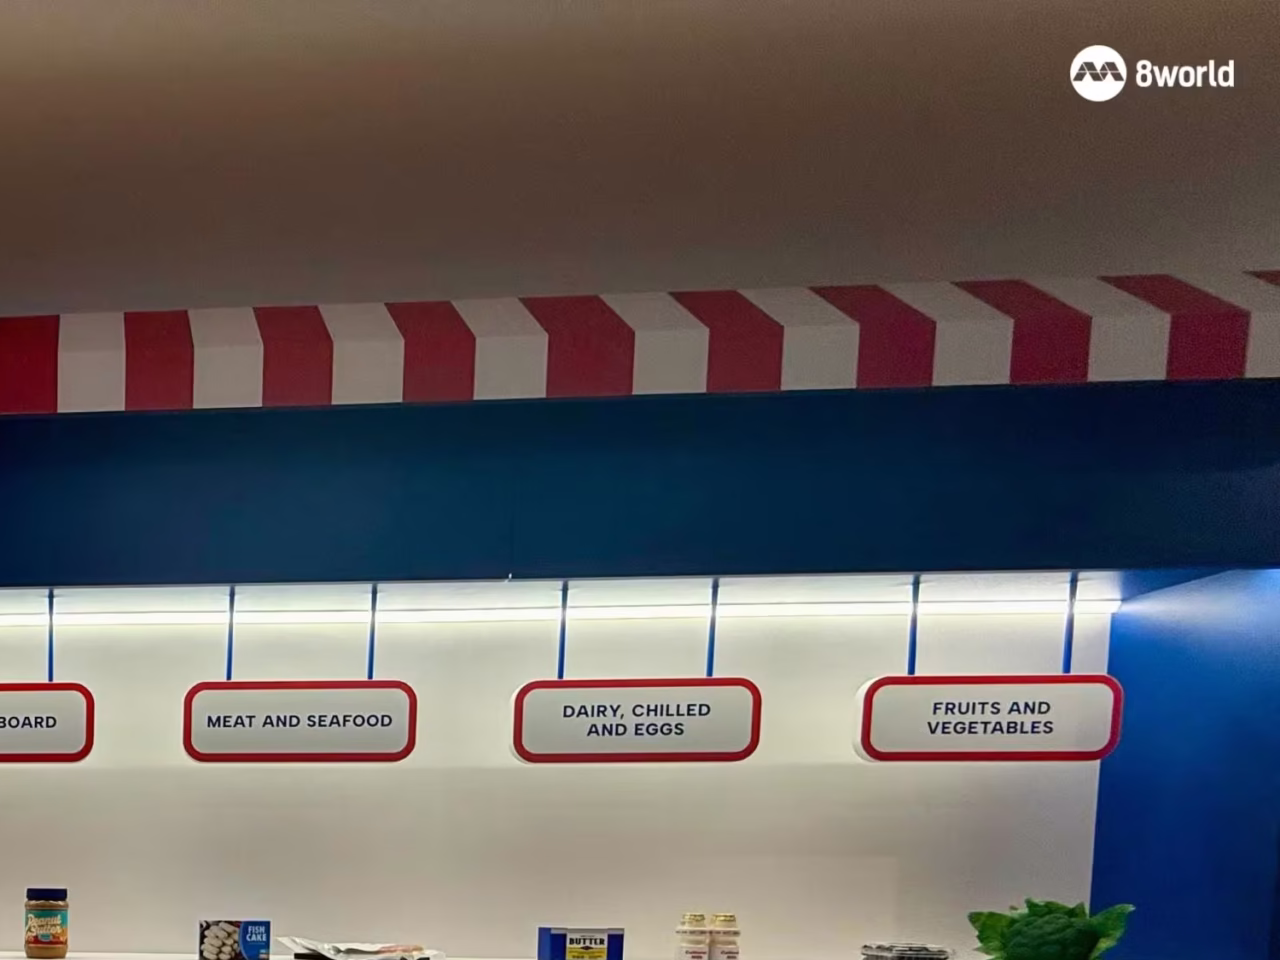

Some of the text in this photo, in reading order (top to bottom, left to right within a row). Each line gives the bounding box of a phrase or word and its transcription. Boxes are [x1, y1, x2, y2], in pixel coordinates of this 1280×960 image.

[563, 703, 711, 720] DAIRY, CHILLED
[932, 701, 1051, 716] FRUITS AND
[207, 714, 393, 728] MEAT AND SEAFOOD
[927, 720, 1054, 735] VEGETABLES
[586, 722, 685, 737] AND EGGS
[27, 913, 62, 926] Peanut
[247, 925, 266, 934] FISH
[246, 933, 267, 942] CAKE
[568, 937, 606, 945] BUTTER
